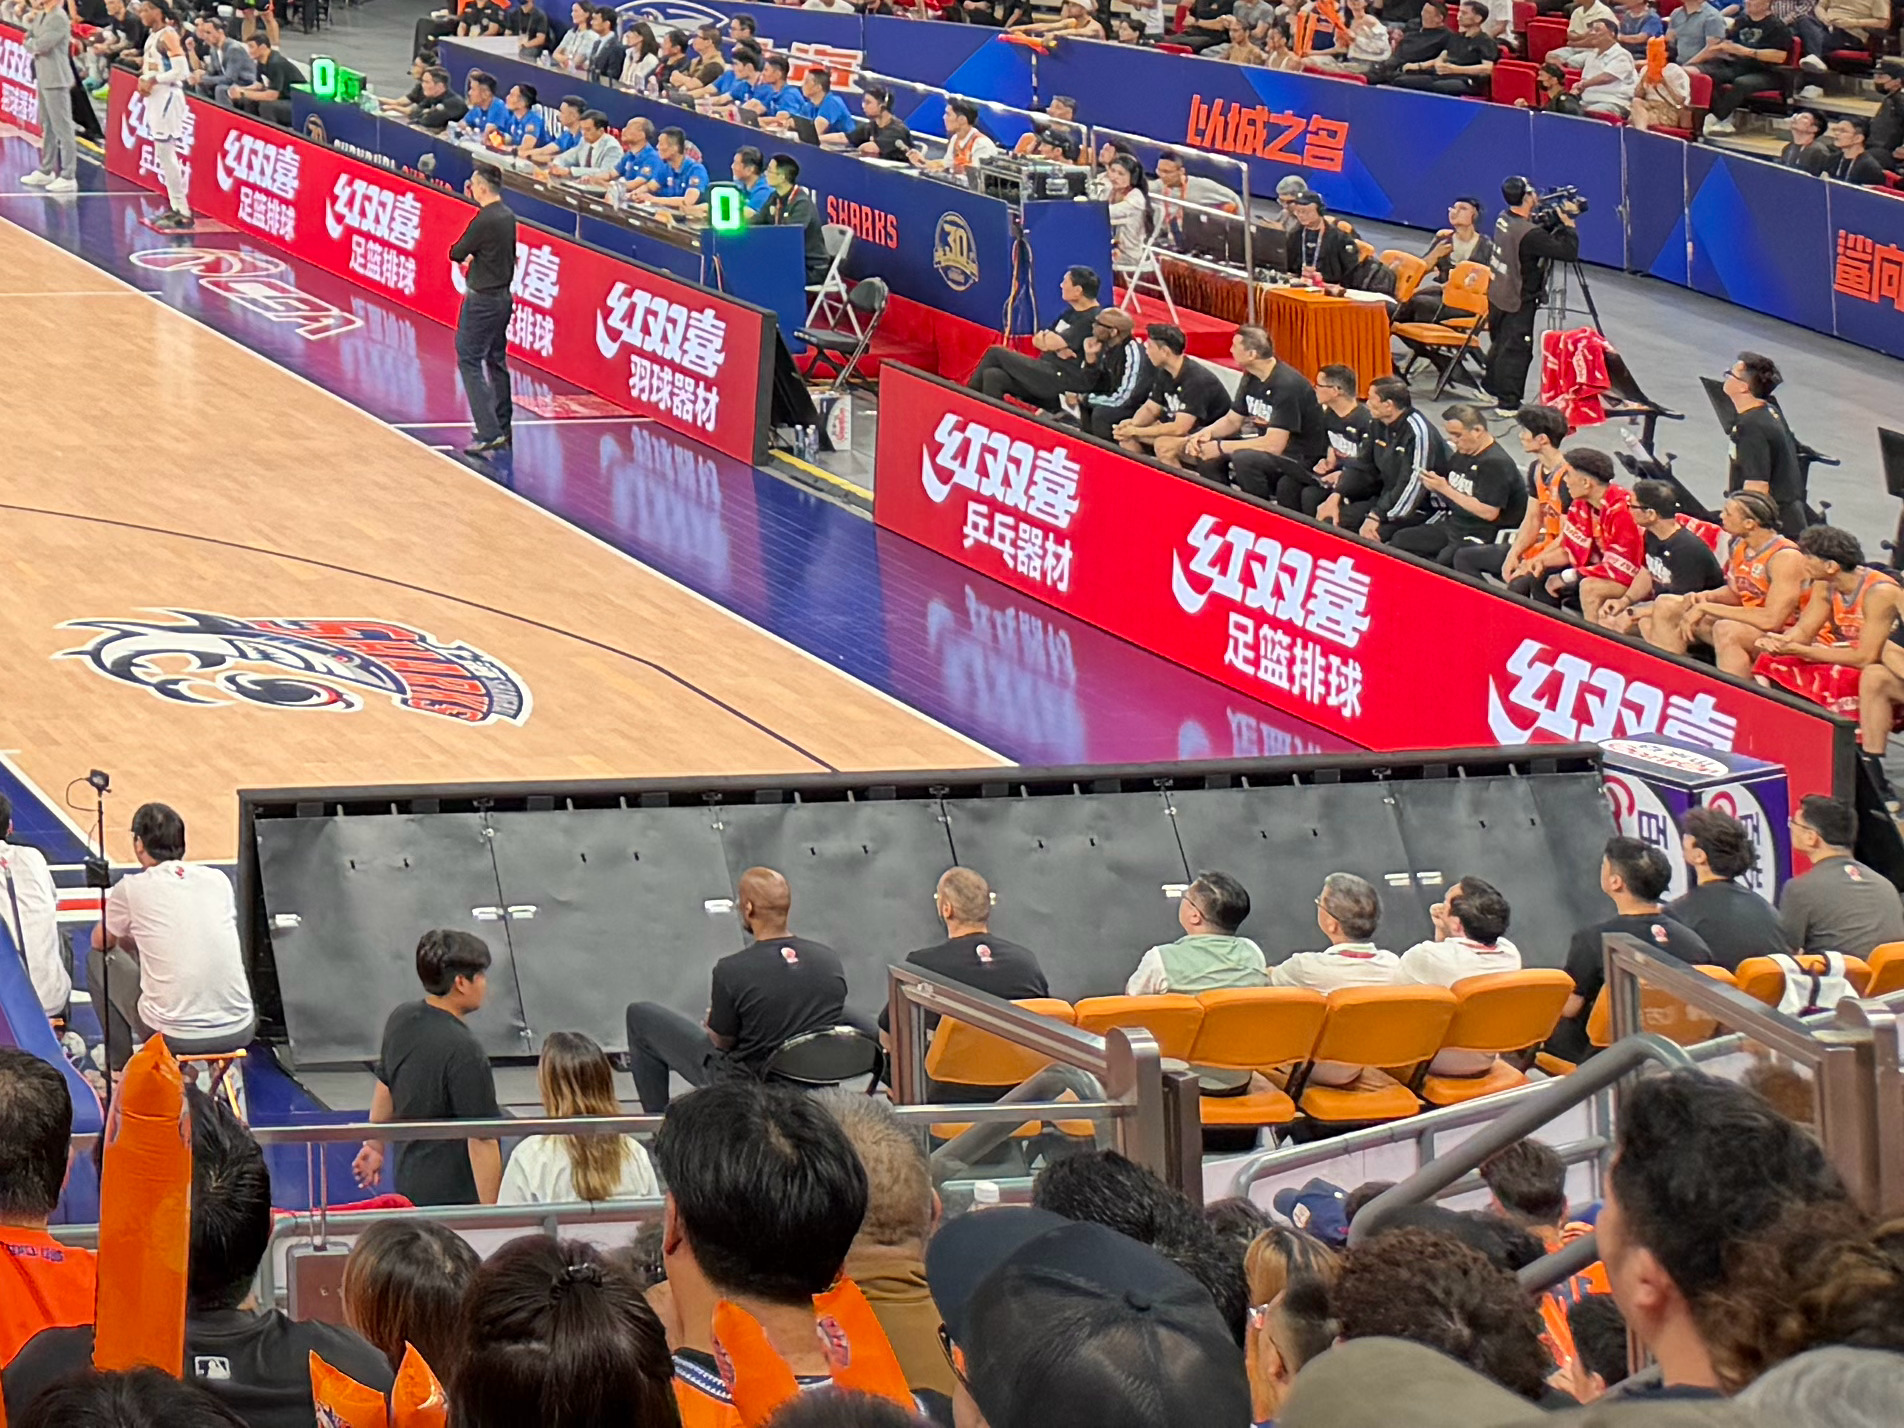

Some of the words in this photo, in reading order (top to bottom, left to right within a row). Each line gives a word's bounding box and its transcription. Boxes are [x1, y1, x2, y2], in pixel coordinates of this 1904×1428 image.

[311, 54, 338, 99] 0
[222, 129, 300, 199] 红双喜
[1186, 94, 1350, 172] 以城之名
[238, 185, 297, 240] 足篮排球
[333, 172, 421, 250] 红双喜
[713, 185, 742, 232] 0
[827, 195, 899, 250] SHARKS
[942, 220, 972, 264] 30
[348, 233, 416, 296] 足篮排球
[606, 280, 728, 378] 红双喜
[628, 353, 721, 432] 羽球器材
[930, 412, 1081, 529] 红双喜
[960, 508, 1074, 594] 乒乓器材
[1185, 512, 1373, 649] 红双喜
[1224, 610, 1364, 721] 足篮排球
[1502, 637, 1739, 752] 红双喜
